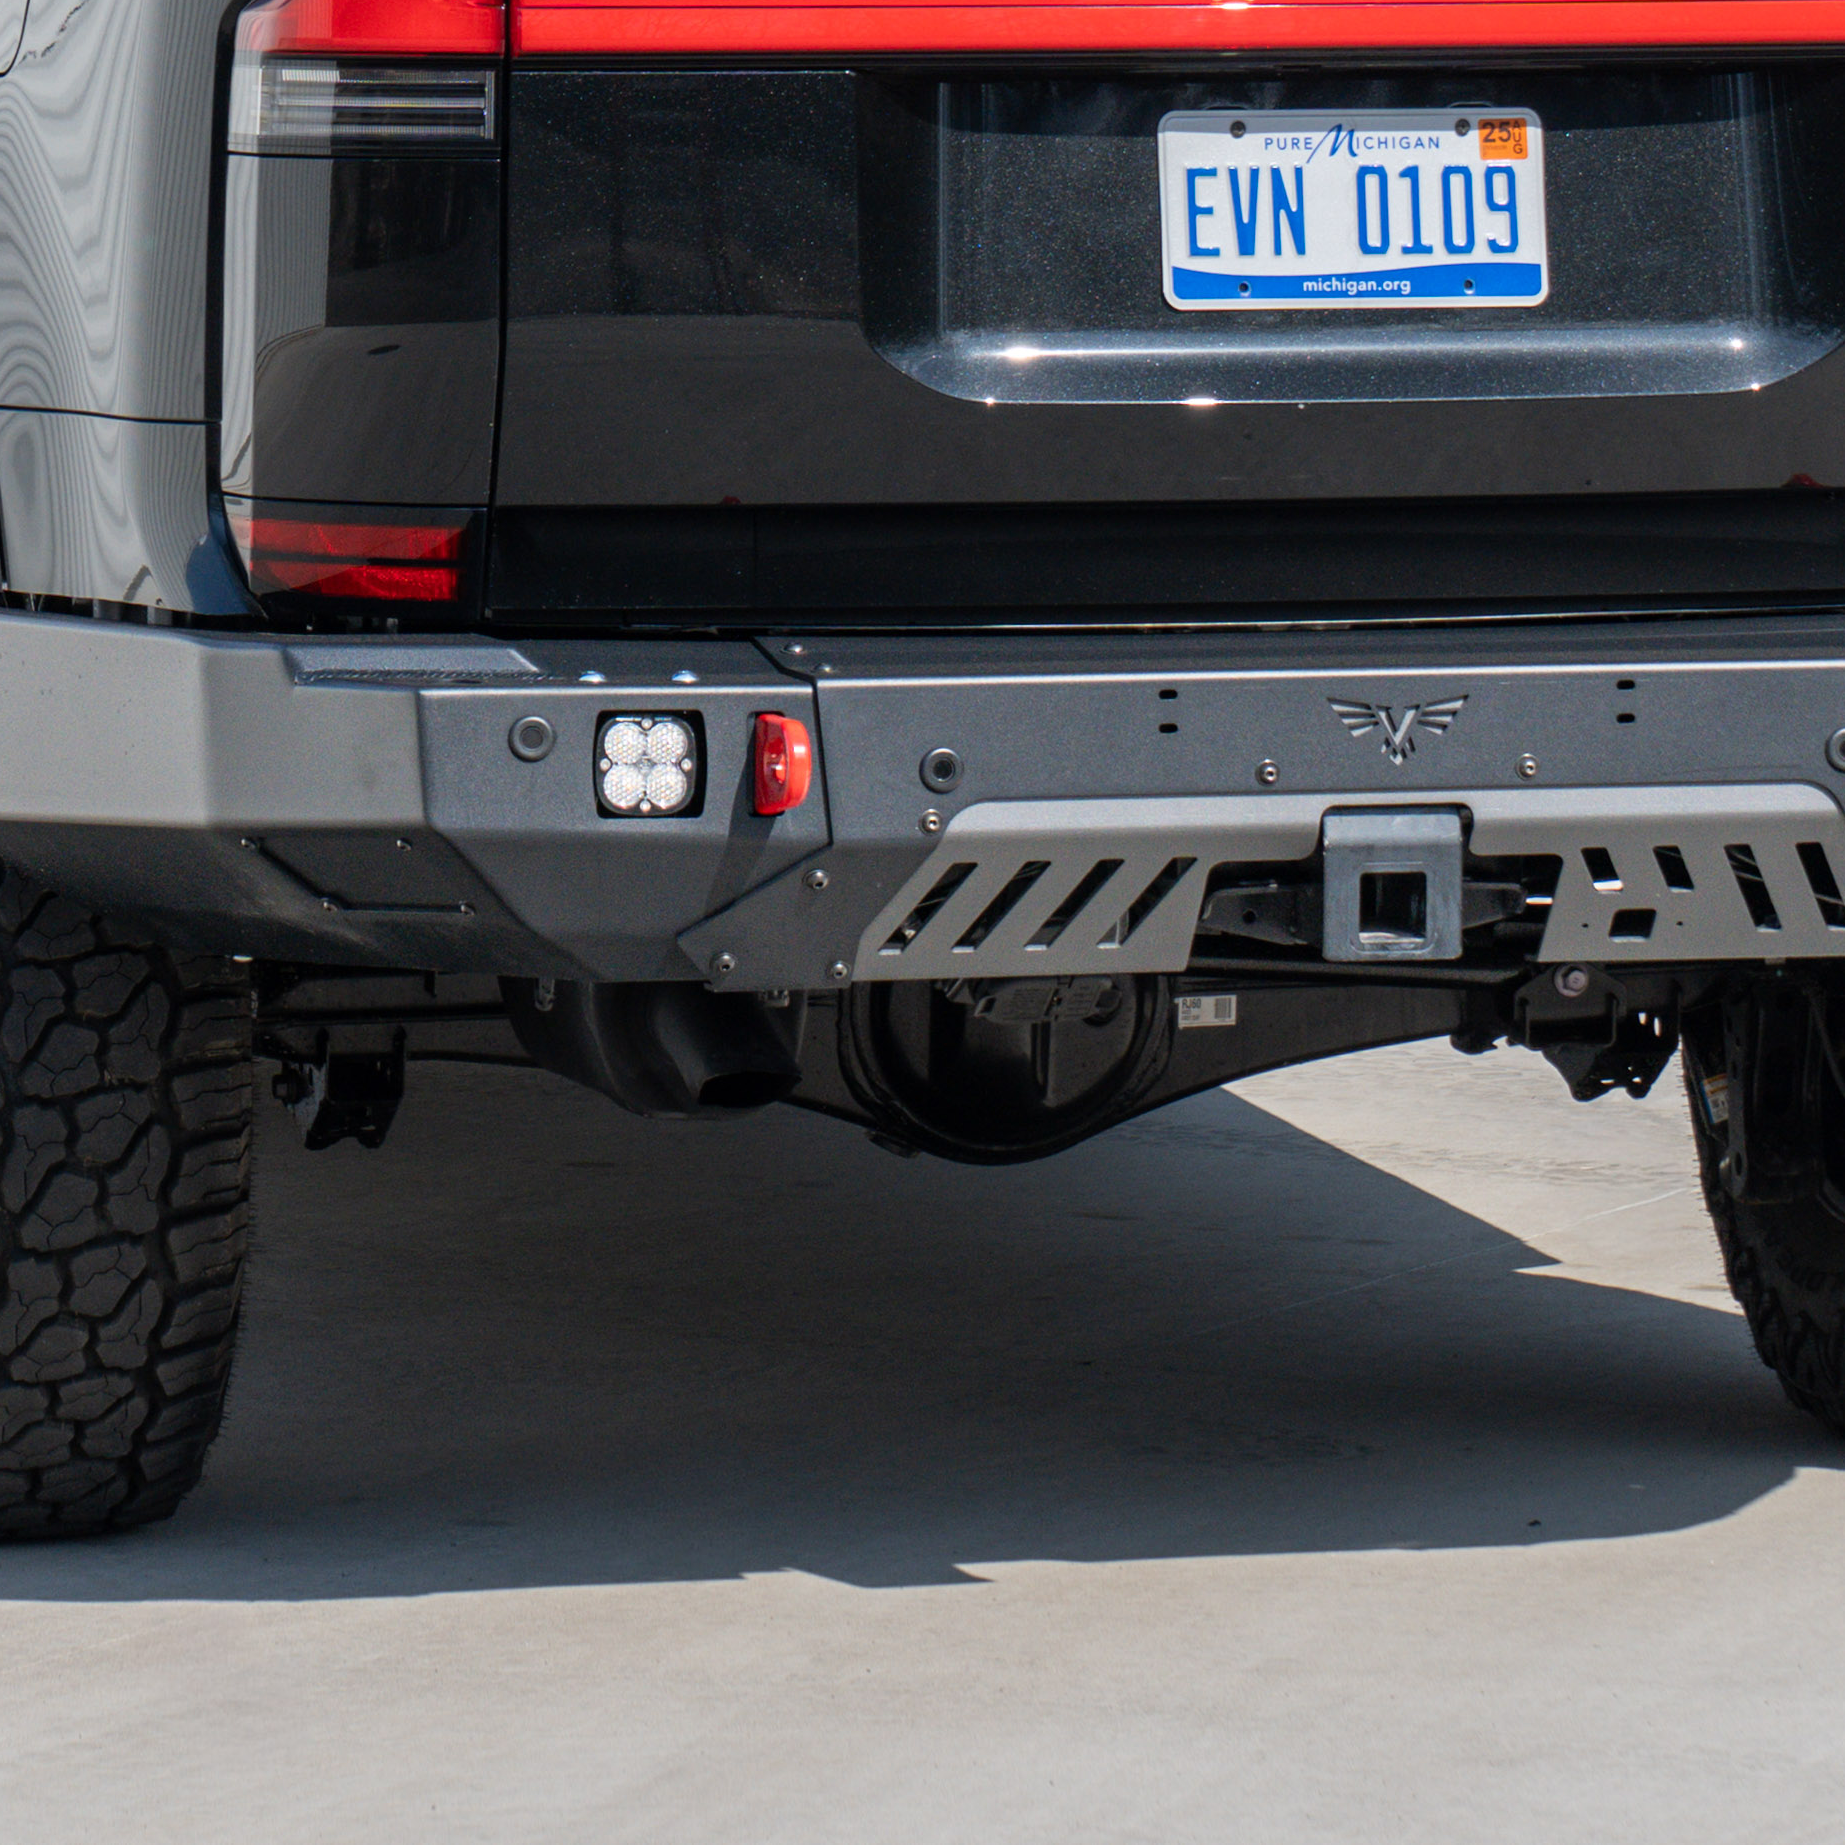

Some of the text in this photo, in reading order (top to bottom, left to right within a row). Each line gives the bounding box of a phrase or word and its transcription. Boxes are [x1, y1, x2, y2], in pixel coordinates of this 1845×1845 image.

[1263, 123, 1440, 164] PURE MICHIGAN
[1482, 121, 1512, 143] 25
[1512, 120, 1524, 155] AUG
[1185, 163, 1519, 257] EVN 0109
[1302, 277, 1412, 295] michigan.org
